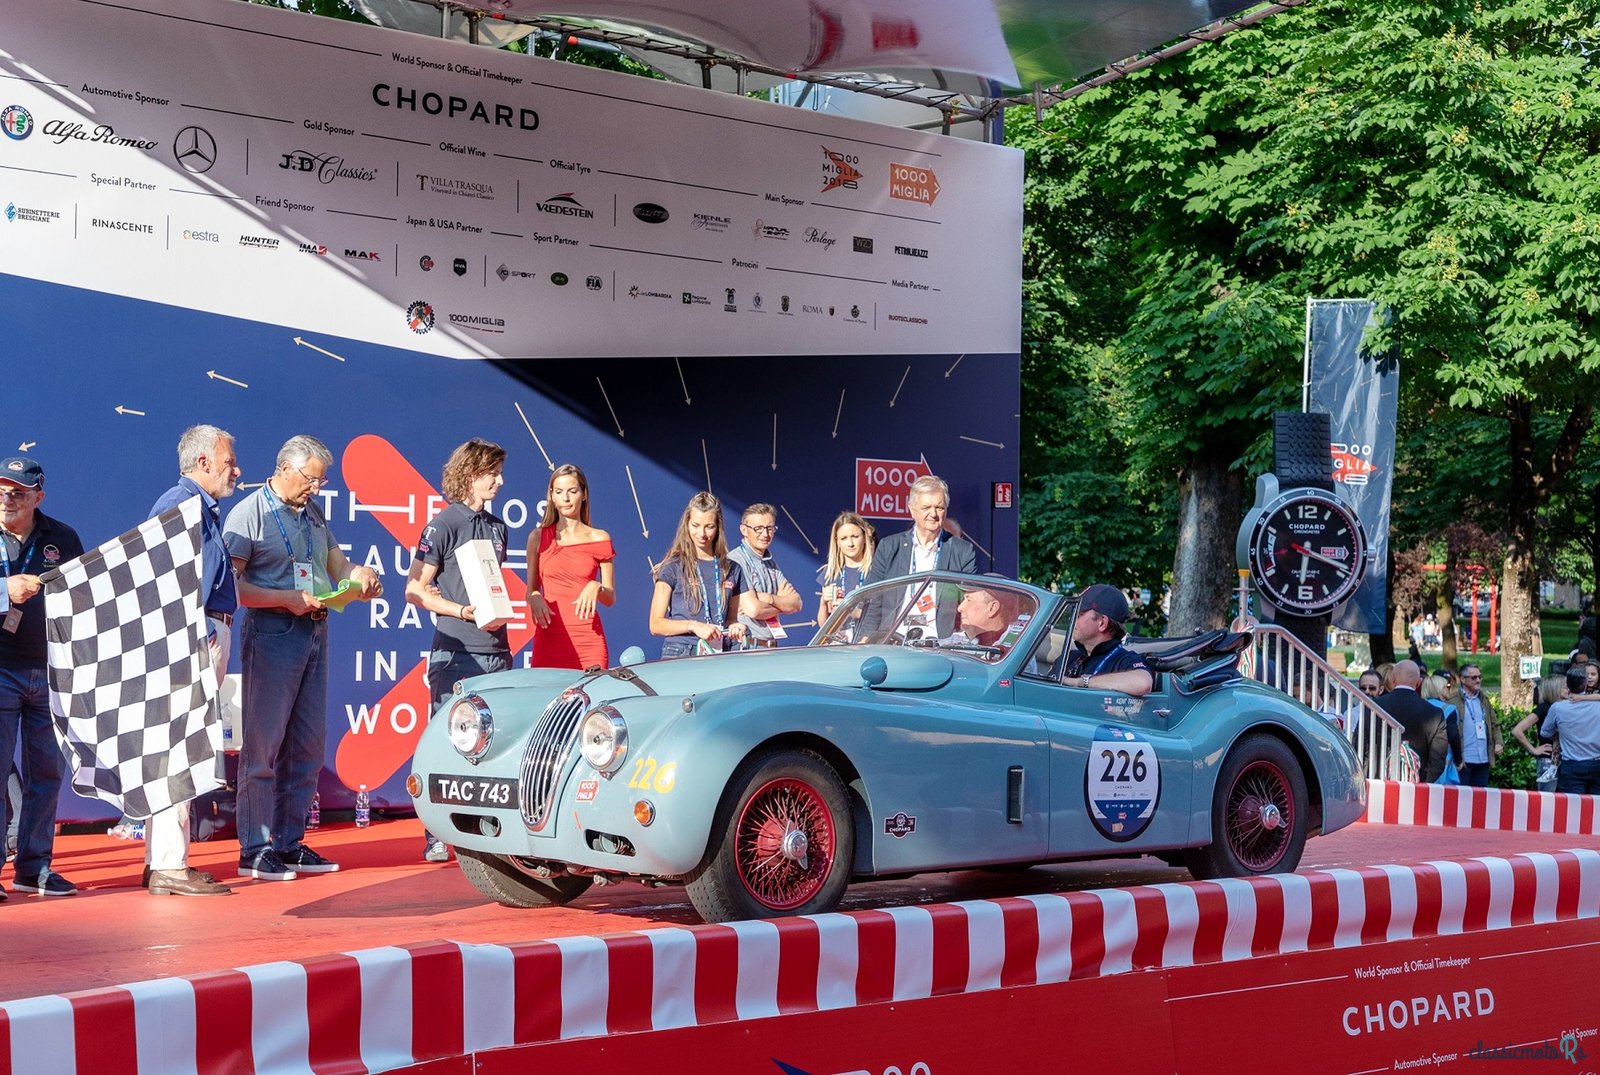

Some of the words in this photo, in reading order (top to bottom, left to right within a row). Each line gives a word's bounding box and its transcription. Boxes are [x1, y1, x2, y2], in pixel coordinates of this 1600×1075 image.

[391, 52, 415, 65] World
[416, 57, 446, 72] Sponsor
[446, 62, 454, 71] &
[455, 63, 482, 77] Official
[482, 68, 523, 85] Timekeeper
[81, 83, 134, 102] Automotive
[135, 91, 170, 107] Sponsor
[372, 83, 540, 131] CHOPARD
[42, 119, 90, 145] Alfa
[90, 124, 158, 150] Romeo
[303, 119, 323, 132] Gold
[324, 123, 355, 137] Sponsor
[439, 142, 465, 155] Official
[465, 146, 487, 158] Wine
[823, 150, 859, 164] 1000
[549, 158, 575, 172] Official
[575, 163, 592, 174] Tyre
[822, 164, 859, 177] MIGLIA
[91, 173, 122, 187] Special
[124, 177, 157, 191] Partner
[823, 175, 859, 190] 2018
[895, 167, 928, 184] 1000
[430, 176, 454, 188] VILLA
[454, 180, 494, 194] TRASQUA
[892, 183, 930, 201] MIGLIA
[255, 195, 282, 208] Friend
[283, 200, 315, 213] Sponsor
[765, 192, 780, 203] Main
[781, 195, 805, 207] Sponsor
[17, 213, 51, 224] BRESCIANE
[18, 207, 60, 219] RUBINETTERIE
[536, 202, 594, 219] VREDESTEIN
[693, 213, 732, 224] KIENLE
[92, 218, 154, 234] RINASCENTE
[406, 215, 428, 229] Japan
[428, 218, 436, 228] &
[437, 220, 455, 231] USA
[455, 222, 483, 234] Partner
[192, 230, 220, 243] estra
[240, 234, 280, 246] HUNTER
[533, 232, 553, 244] Sport
[554, 235, 579, 246] Partner
[805, 227, 837, 251] Perlage
[344, 248, 380, 259] MAK
[731, 258, 759, 270] Patrocini
[511, 270, 536, 280] SPORT
[586, 277, 601, 289] FIA
[891, 279, 909, 289] Media
[909, 281, 930, 292] Partner
[802, 304, 824, 315] ROMA
[1333, 457, 1372, 472] GLIA
[865, 466, 918, 488] 1000
[1334, 473, 1369, 486] 18
[861, 492, 911, 514] MIGLI
[1297, 505, 1318, 519] 12
[1337, 549, 1343, 557] 8
[1298, 585, 1313, 600] 6
[354, 651, 397, 682] IN
[1100, 749, 1147, 783] 226
[627, 757, 678, 794] 226
[438, 779, 474, 802] TAC
[478, 782, 511, 805] 743
[1354, 965, 1376, 979] World
[1376, 963, 1403, 978] Sponsor
[1403, 962, 1411, 973] &
[1411, 958, 1435, 972] Official
[1435, 955, 1472, 969] Timekeeper
[1342, 987, 1495, 1037] CHOPARD
[1575, 1027, 1598, 1042] Sponsor
[1393, 1055, 1432, 1070] Automotive
[1432, 1051, 1458, 1066] Sponsor
